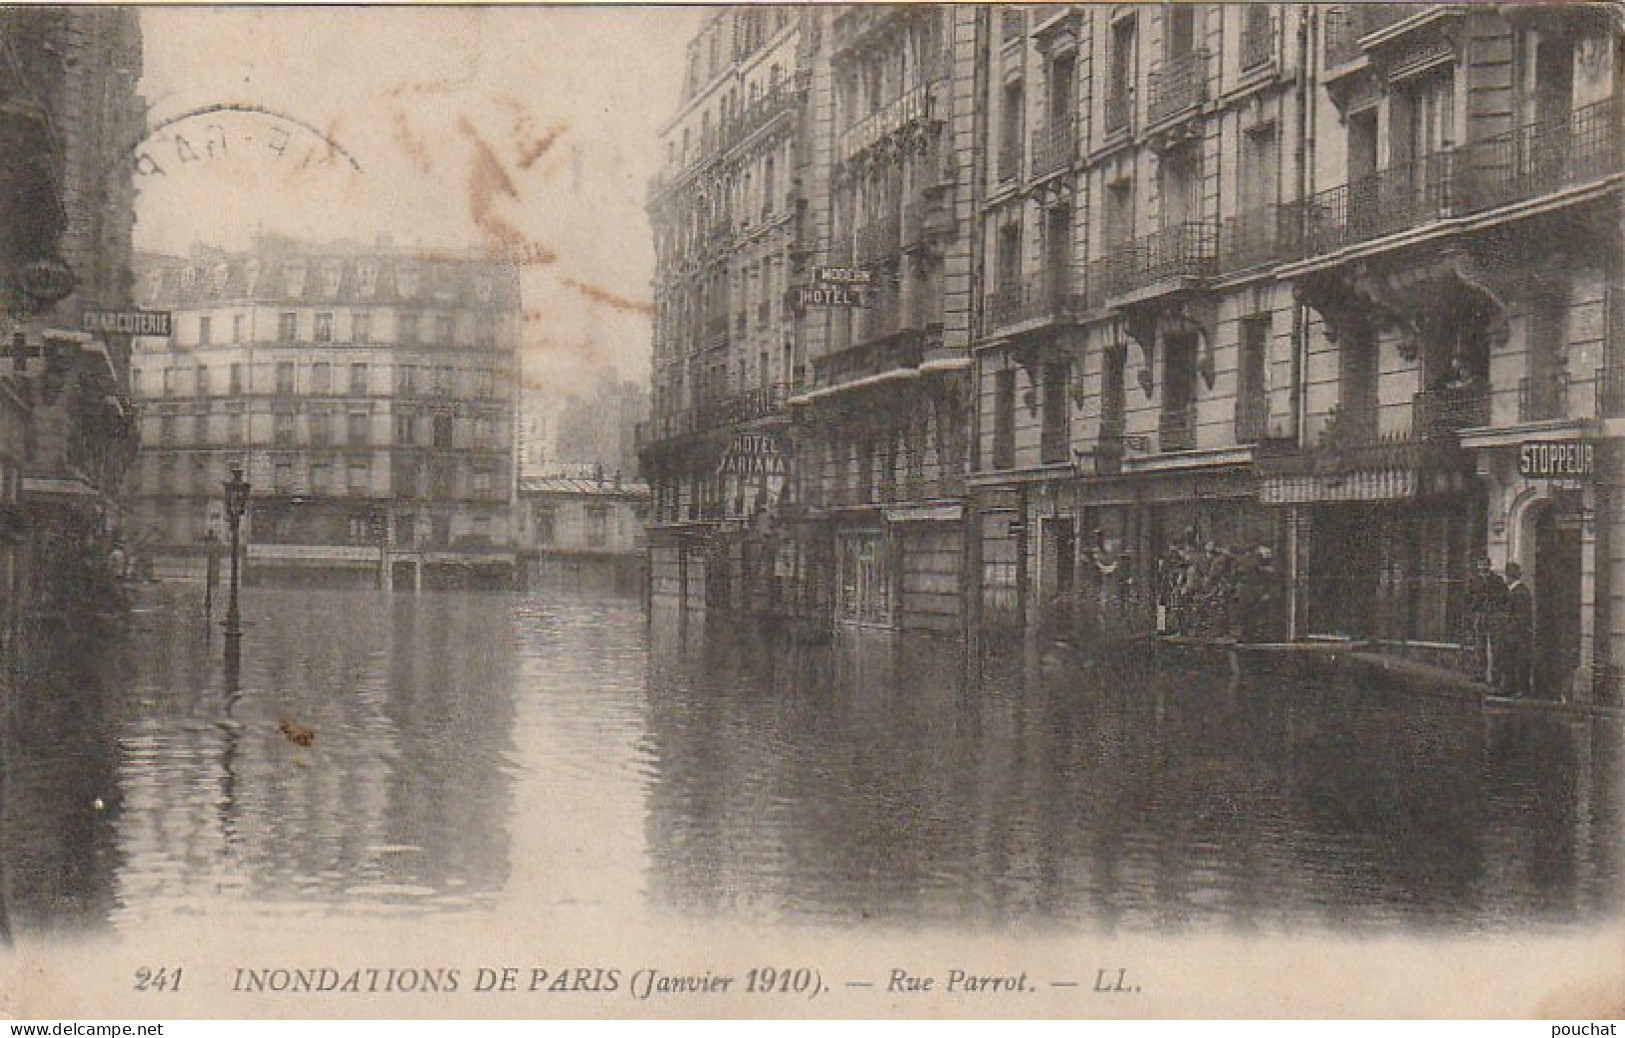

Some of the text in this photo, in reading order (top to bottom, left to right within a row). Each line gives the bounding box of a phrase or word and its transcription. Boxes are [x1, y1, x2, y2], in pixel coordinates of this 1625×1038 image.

[803, 290, 852, 304] HOTEL
[734, 434, 780, 455] HOTEL
[1520, 443, 1594, 474] STOPPEUR
